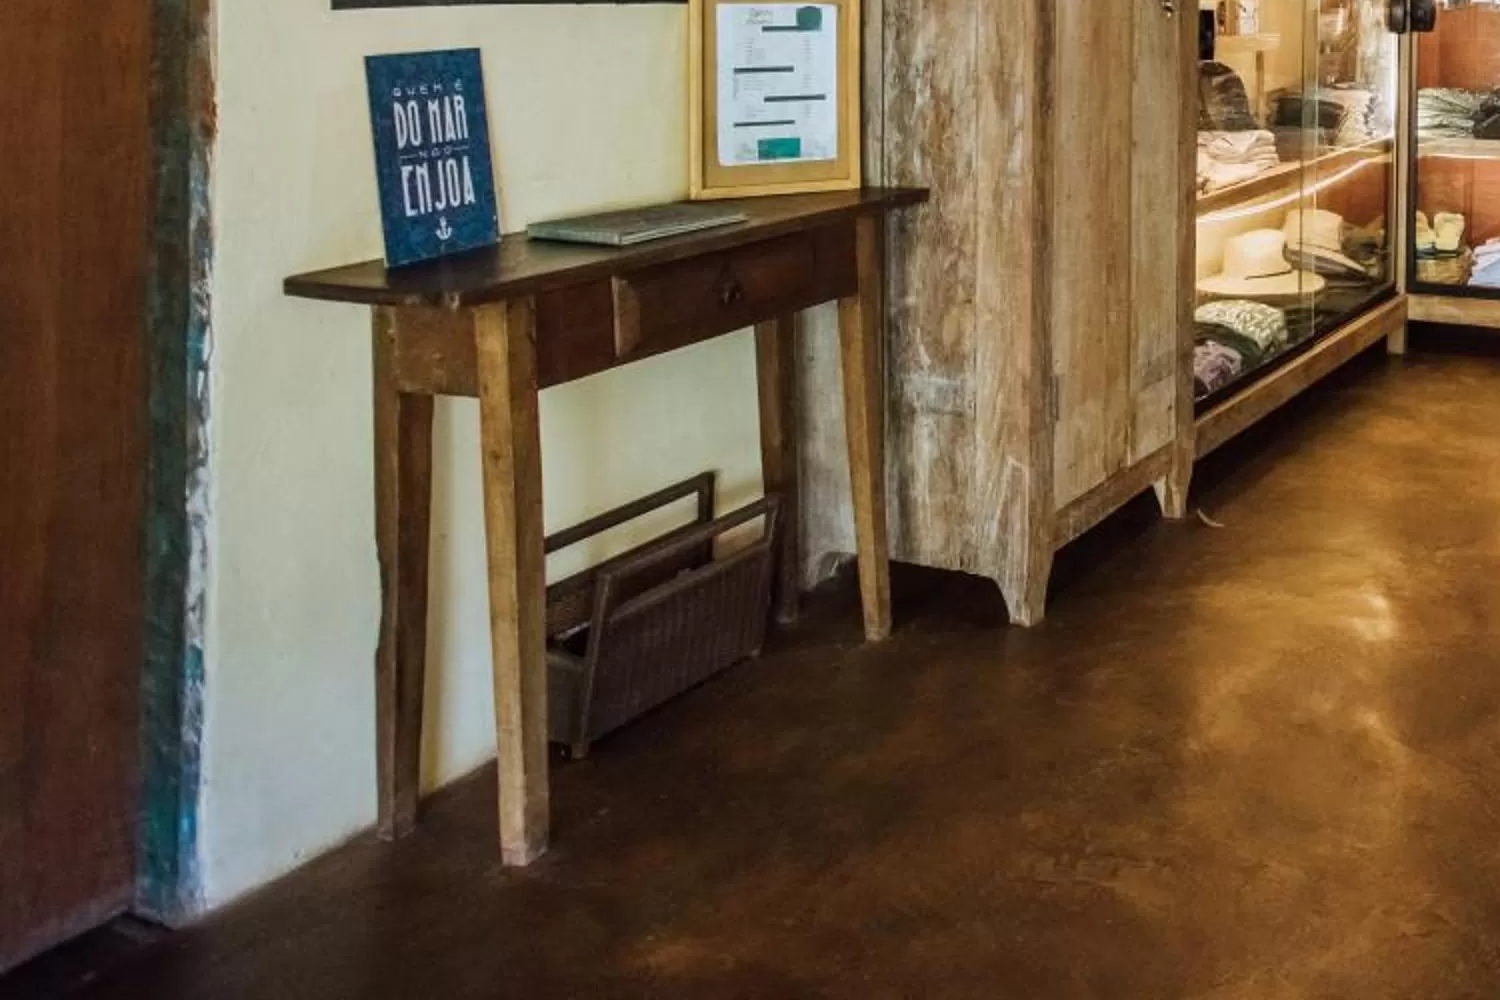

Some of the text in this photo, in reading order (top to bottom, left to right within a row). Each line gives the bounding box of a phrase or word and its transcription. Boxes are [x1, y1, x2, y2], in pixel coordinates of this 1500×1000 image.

[393, 95, 469, 149] DO MAR
[401, 156, 476, 217] ENJOA
